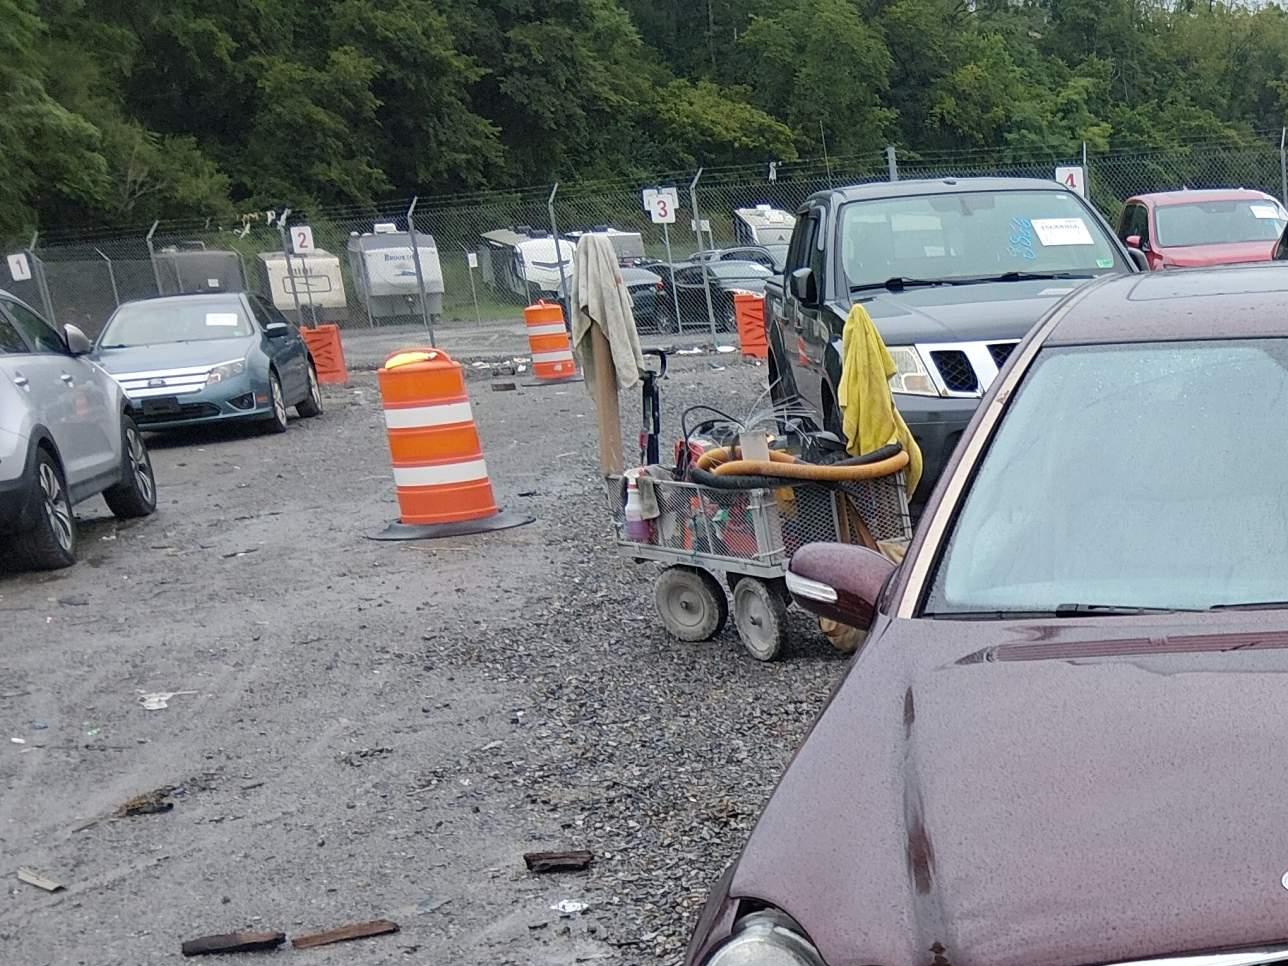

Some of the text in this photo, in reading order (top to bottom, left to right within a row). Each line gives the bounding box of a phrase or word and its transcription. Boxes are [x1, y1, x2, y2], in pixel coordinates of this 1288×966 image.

[1065, 173, 1077, 188] 4
[656, 199, 668, 218] 3
[297, 231, 308, 249] 2
[16, 259, 24, 275] 1
